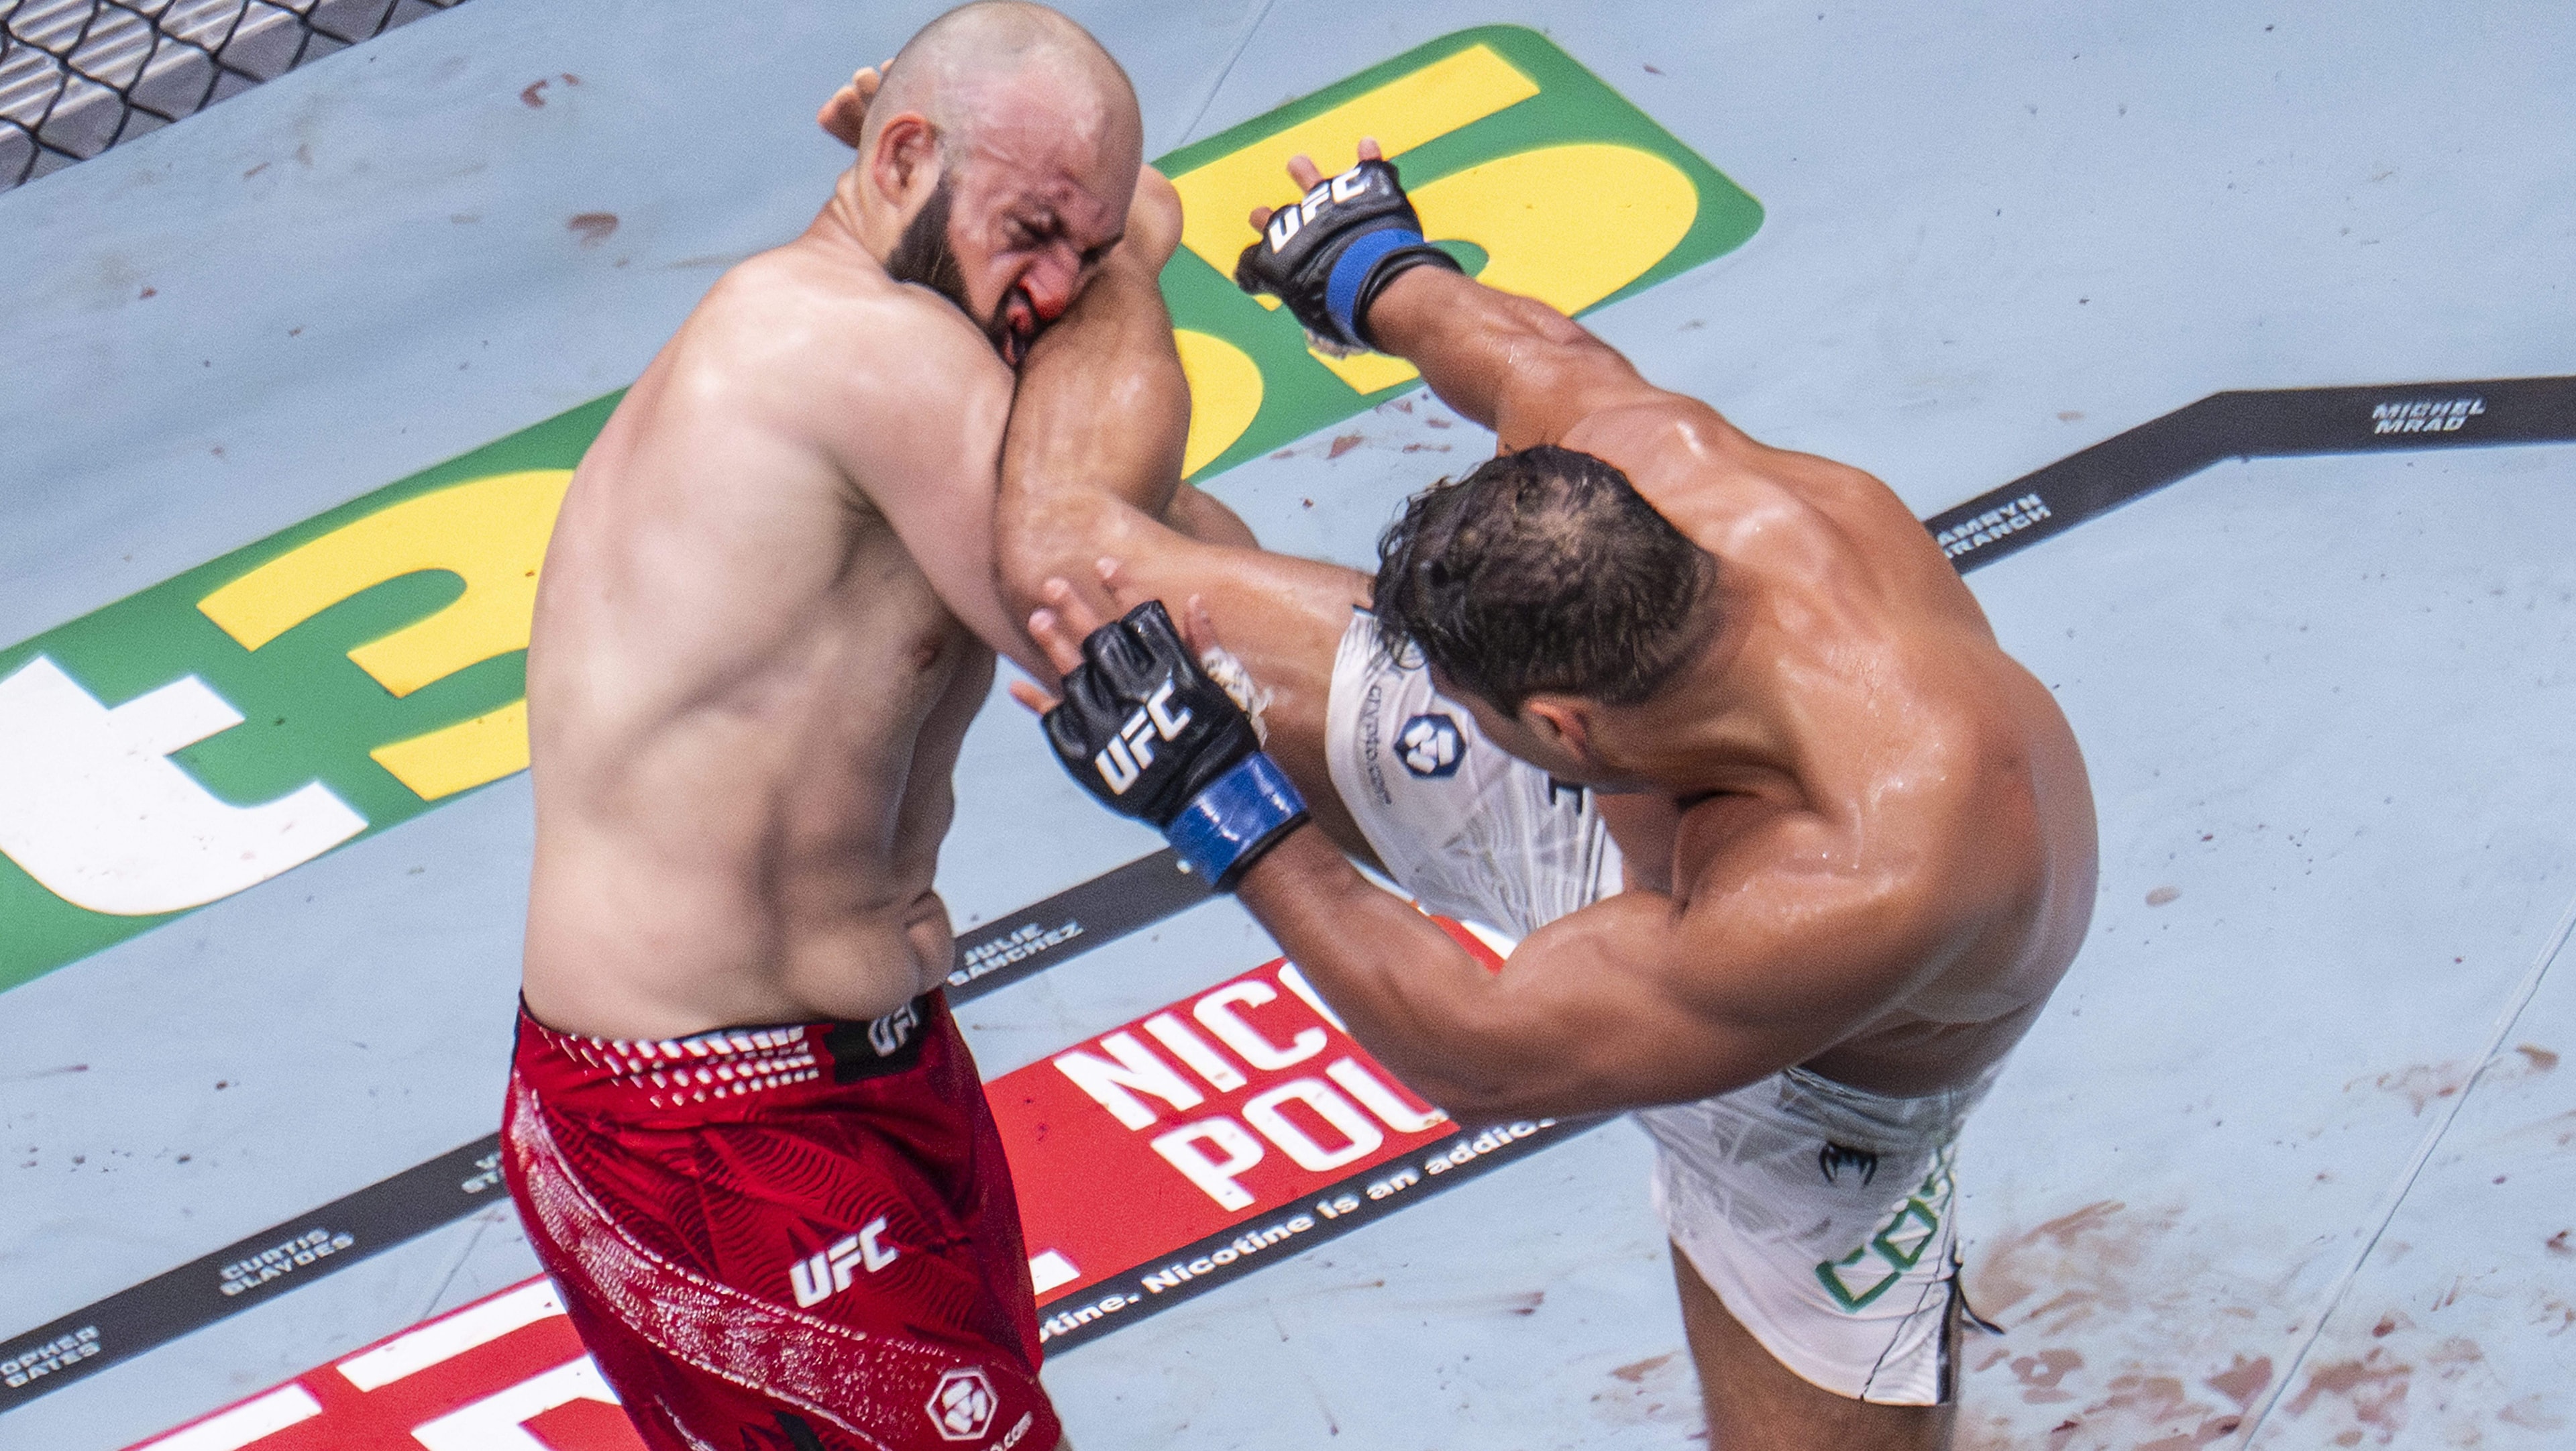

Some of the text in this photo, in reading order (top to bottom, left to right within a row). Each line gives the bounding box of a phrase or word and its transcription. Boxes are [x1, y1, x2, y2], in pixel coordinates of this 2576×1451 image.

[1269, 167, 1370, 254] UFC
[2374, 415, 2469, 435] MRAD
[1095, 671, 1193, 796] UFC
[946, 920, 1084, 987] SANCHEZ
[964, 922, 1044, 967] JULIE
[790, 1216, 900, 1309] UFC
[1142, 1214, 1315, 1294] Nicotine
[1316, 1193, 1360, 1220] is
[1366, 1167, 1420, 1201] an
